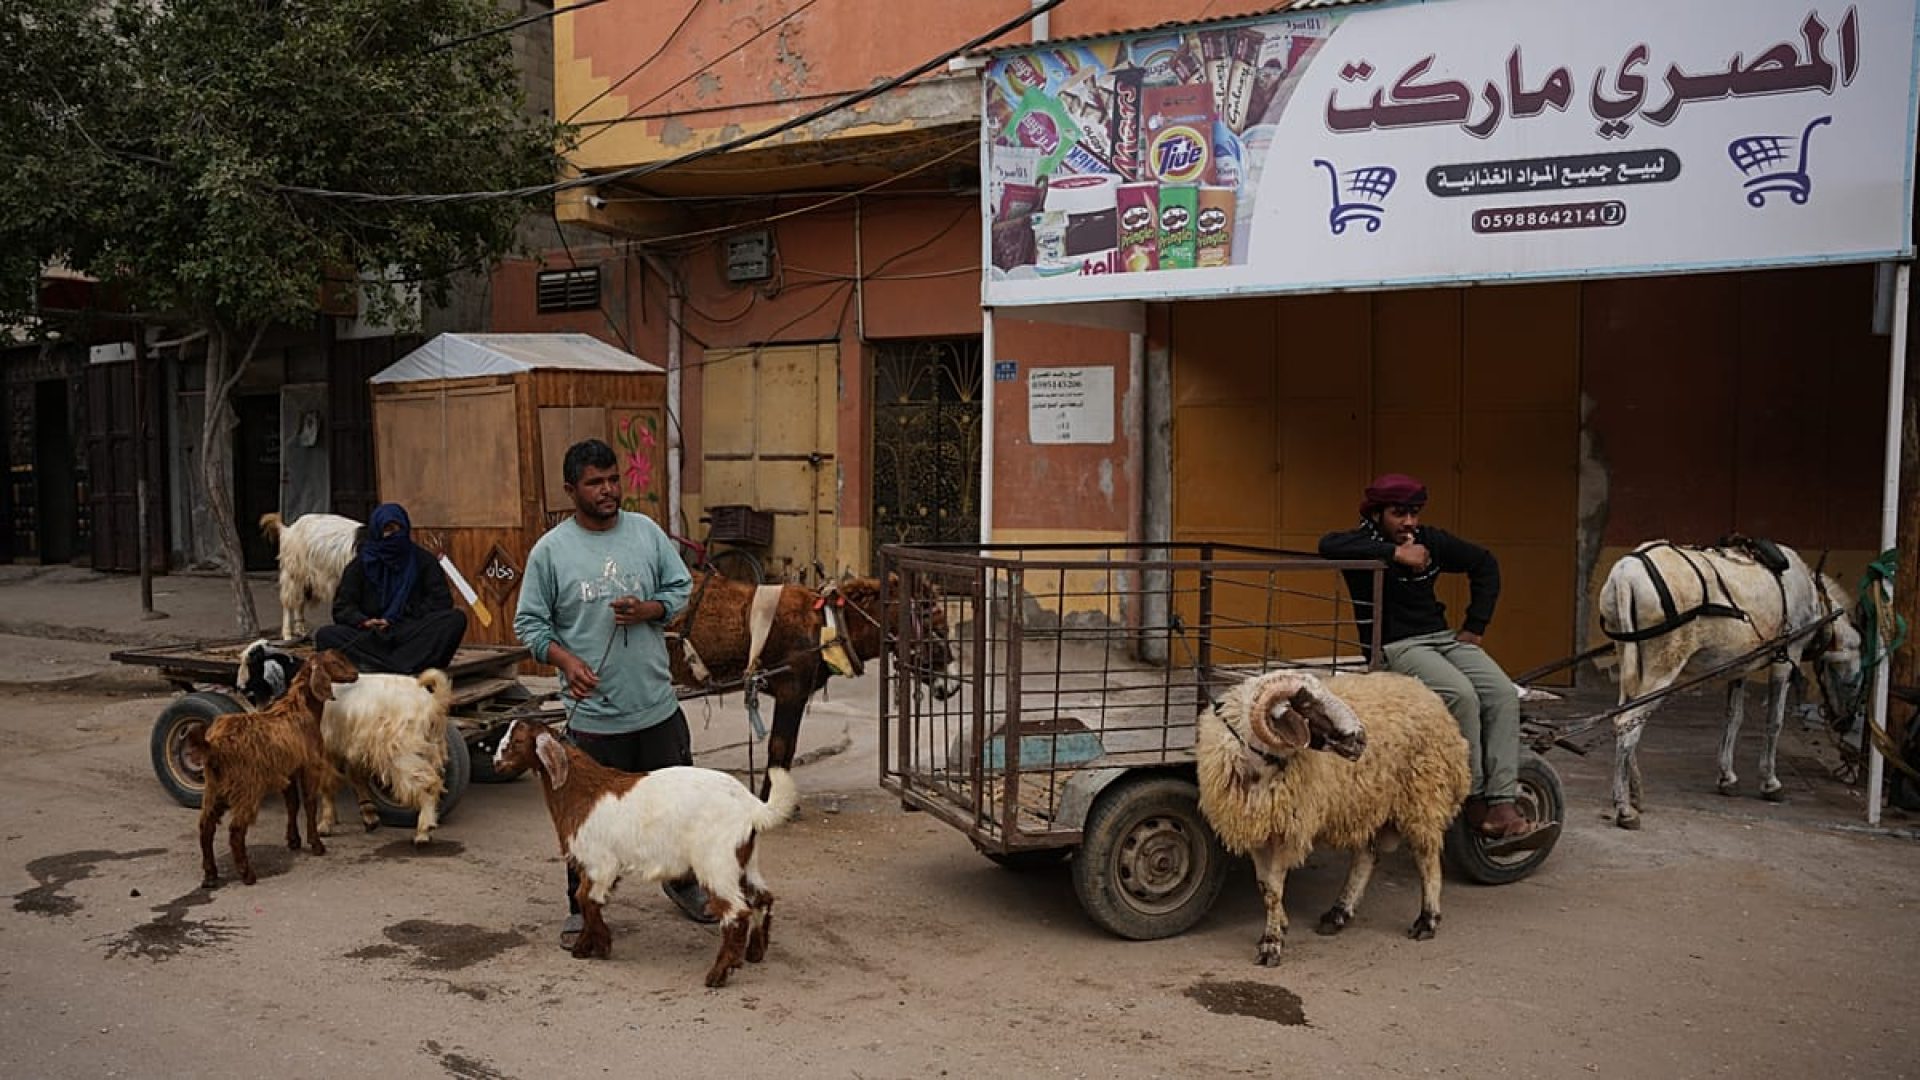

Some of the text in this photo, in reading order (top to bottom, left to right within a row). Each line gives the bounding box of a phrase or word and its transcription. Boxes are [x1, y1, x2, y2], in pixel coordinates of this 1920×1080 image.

[1325, 5, 1859, 139] المصري ماركت
[1111, 81, 1137, 180] Mars
[1157, 136, 1203, 176] Tide
[1437, 157, 1666, 192] لبيع جميع المواد الغذائية
[1479, 208, 1597, 229] 0598864214
